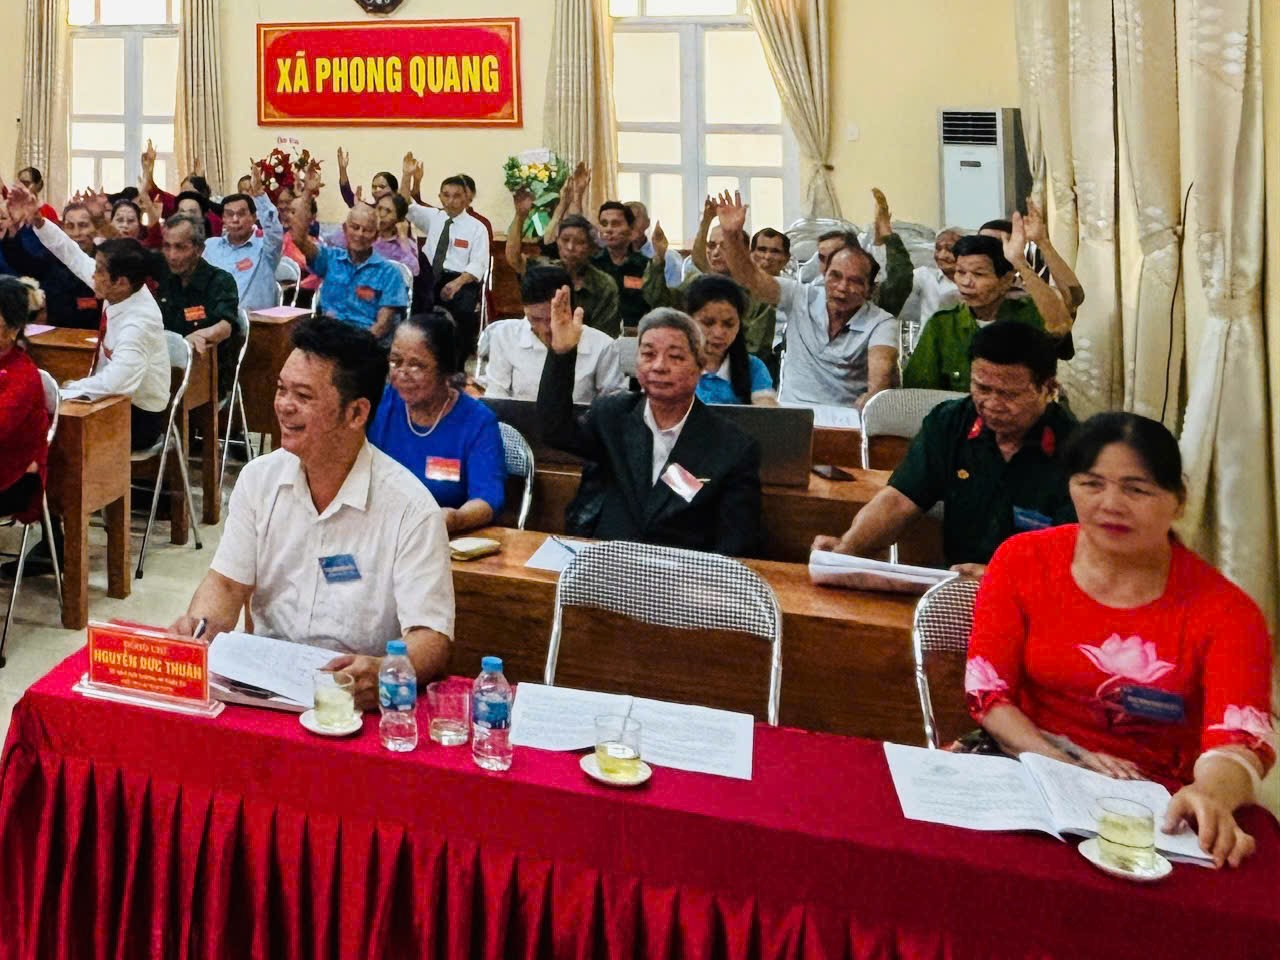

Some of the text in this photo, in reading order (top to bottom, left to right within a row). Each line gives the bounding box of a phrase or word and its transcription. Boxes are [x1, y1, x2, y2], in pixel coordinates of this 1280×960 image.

[277, 51, 500, 98] XÃ PHONG QUANG
